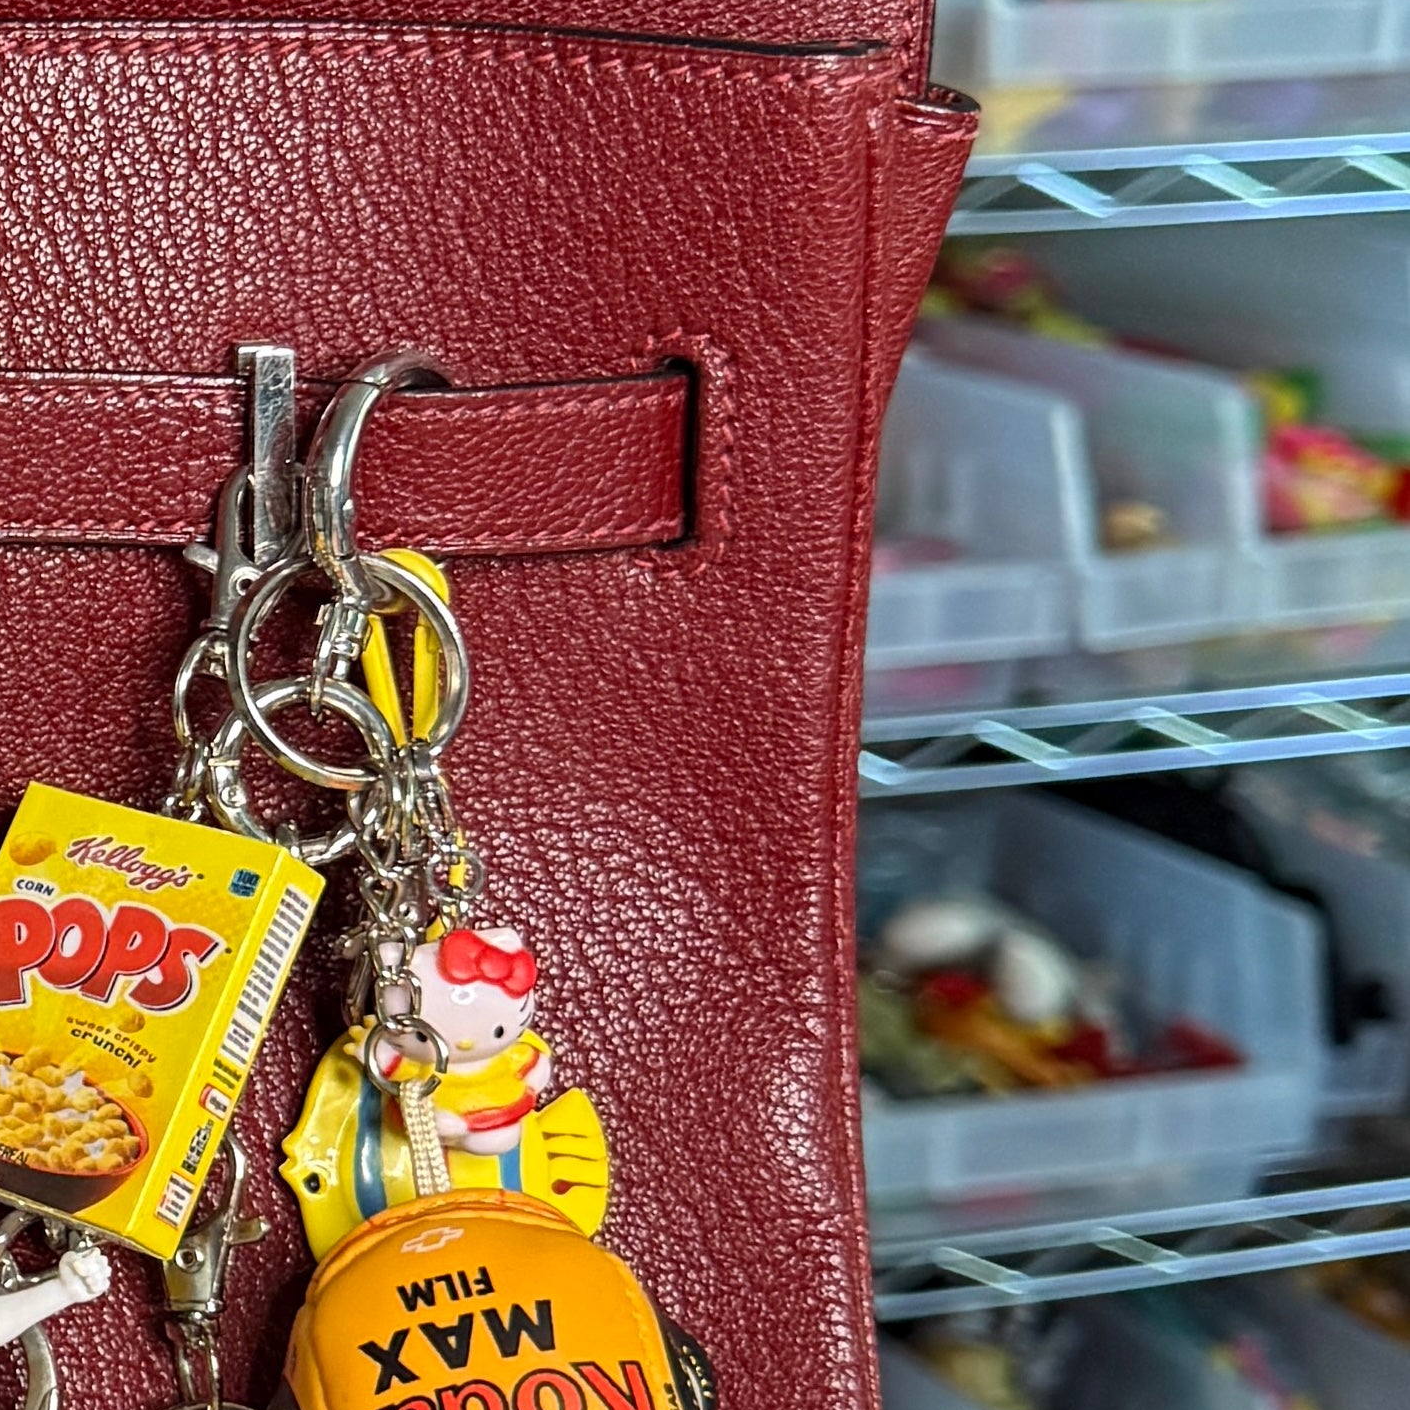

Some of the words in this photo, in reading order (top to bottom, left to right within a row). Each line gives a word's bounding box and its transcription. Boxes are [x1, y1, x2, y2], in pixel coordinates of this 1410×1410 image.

[66, 836, 193, 891] Kellogg's
[16, 878, 55, 897] CORN
[70, 1028, 142, 1069] crunch!
[114, 1033, 157, 1063] crispy
[396, 1266, 496, 1312] FILM
[358, 1299, 556, 1396] MAX
